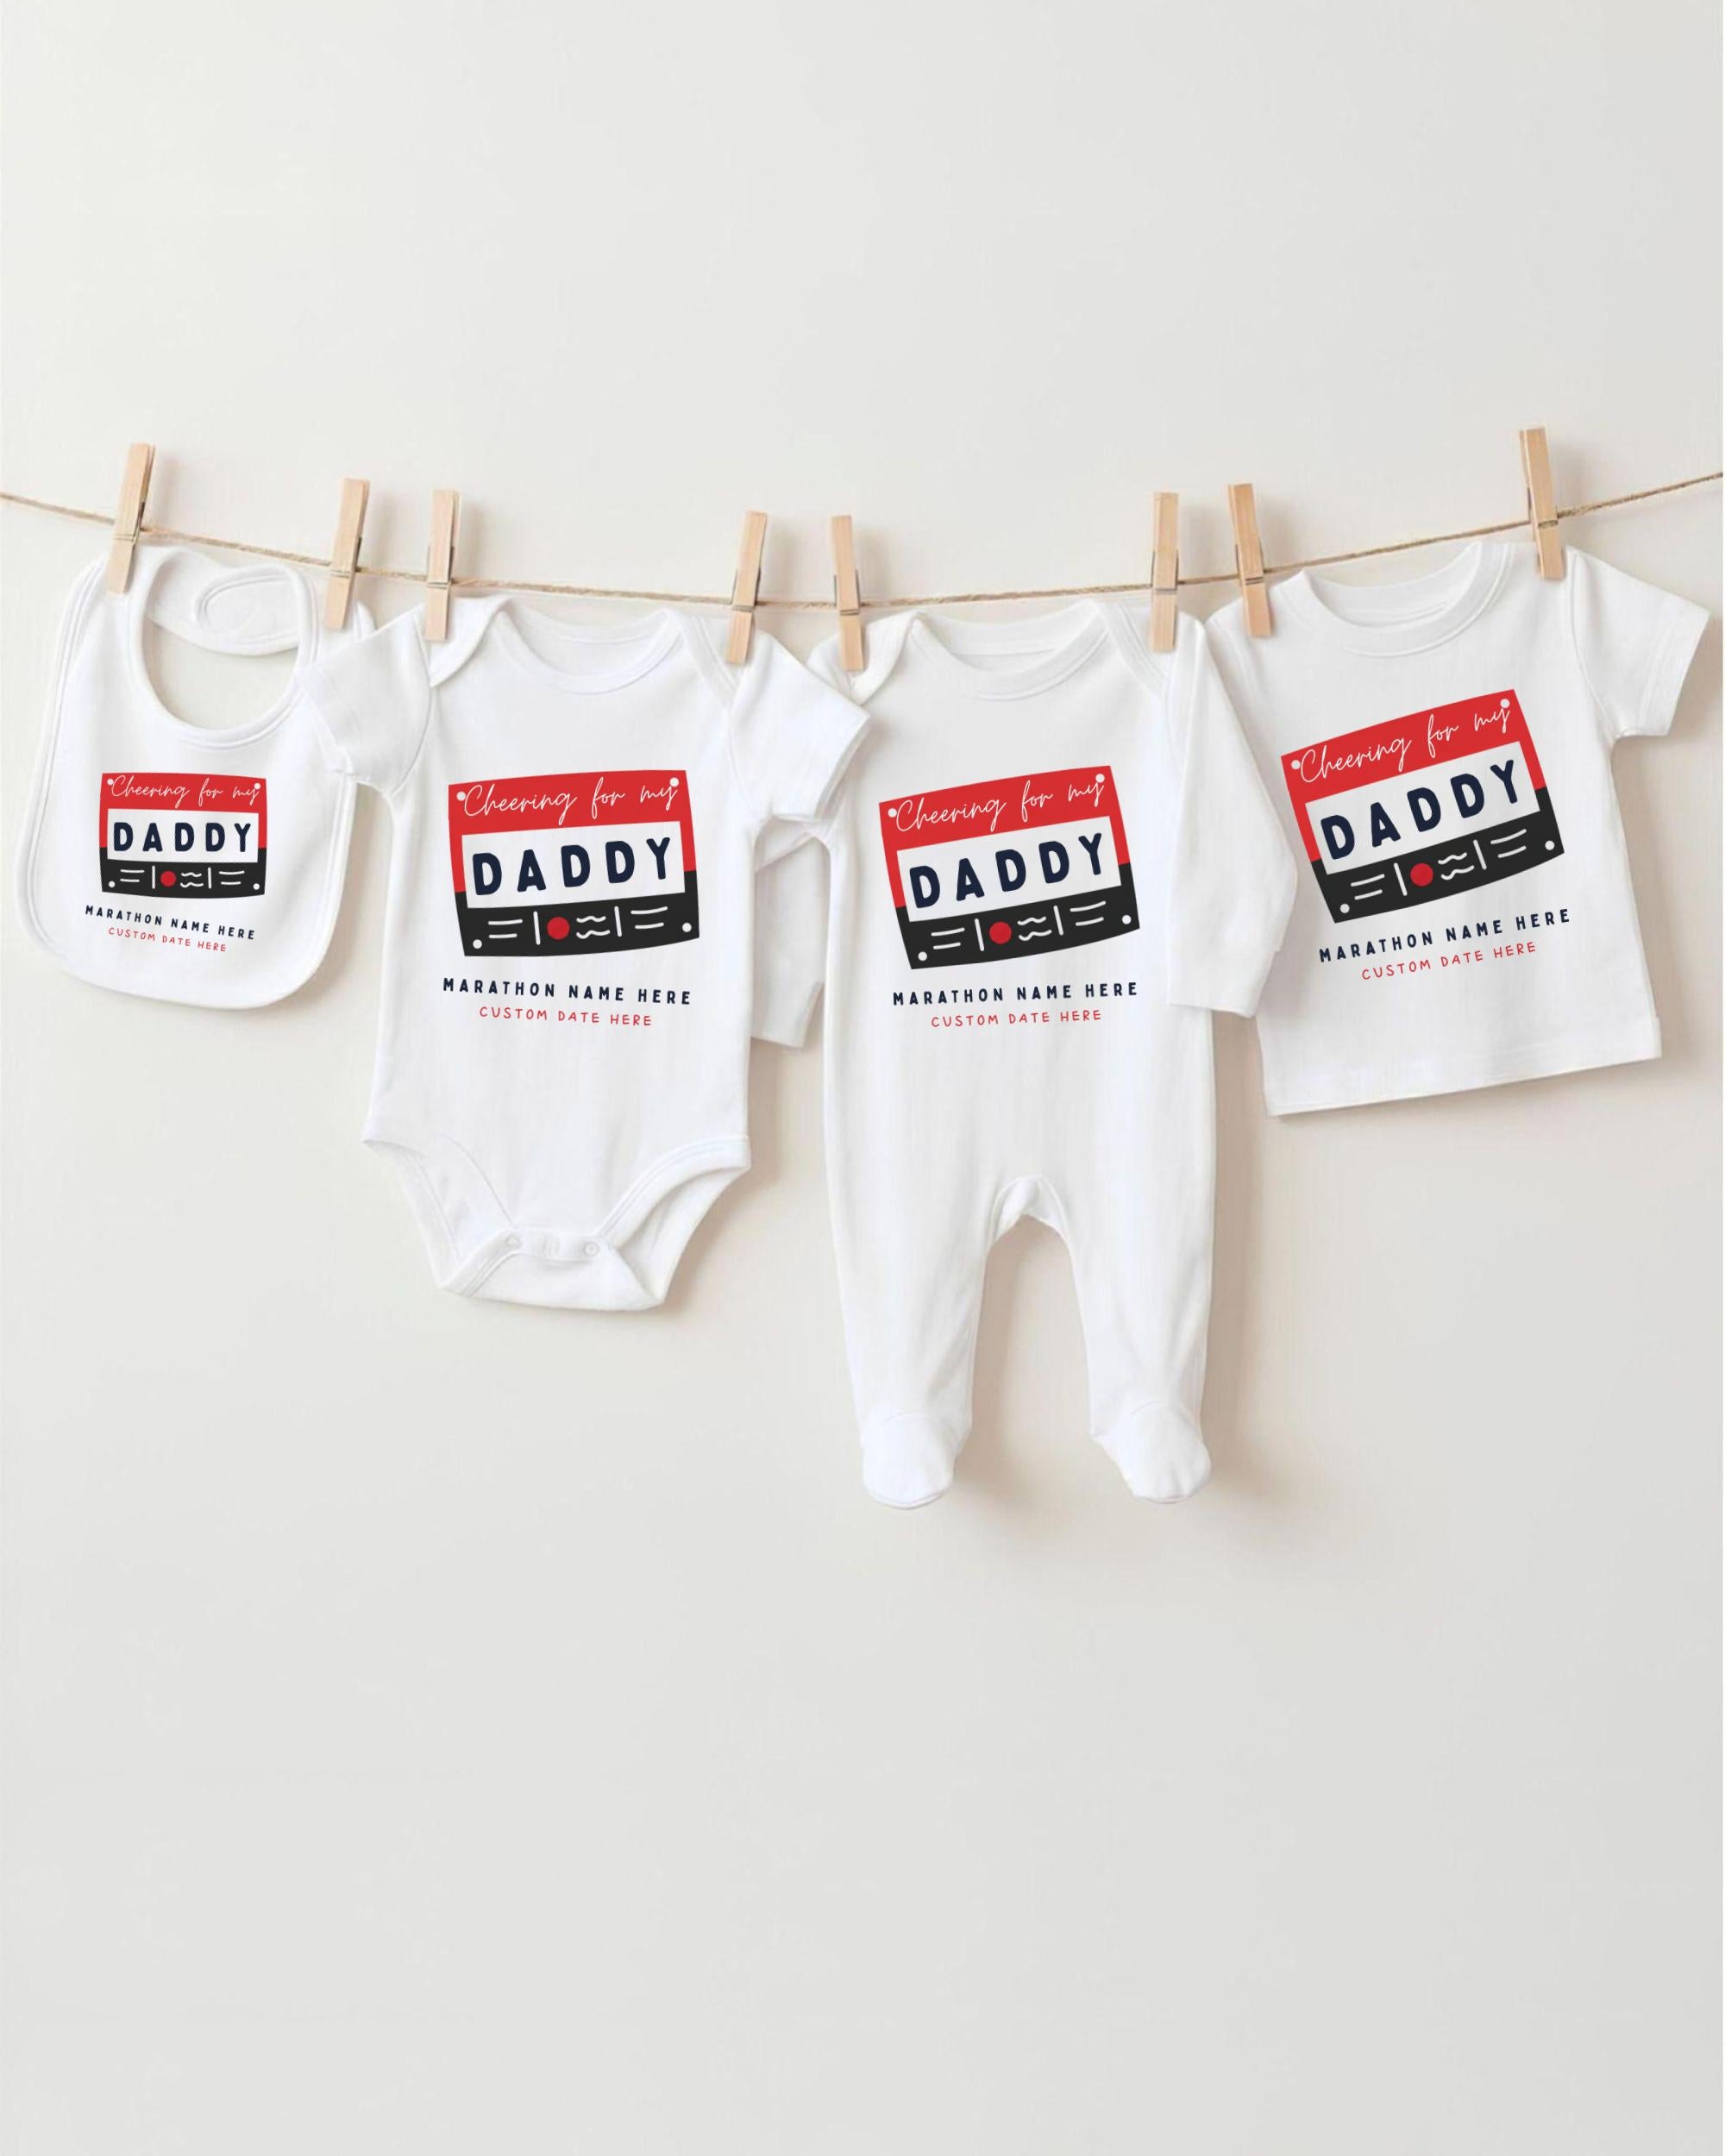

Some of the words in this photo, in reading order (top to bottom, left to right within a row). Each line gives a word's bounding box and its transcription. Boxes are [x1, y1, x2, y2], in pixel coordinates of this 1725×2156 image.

[1300, 734, 1414, 784] Cheering
[1426, 713, 1460, 760] for
[1473, 705, 1512, 735] my
[110, 774, 190, 809] Cheering
[198, 777, 223, 807] for
[231, 783, 260, 806] my
[463, 783, 578, 826] Cheering
[591, 776, 625, 820] for
[639, 782, 679, 812] my
[895, 797, 1007, 832] Cheering
[1021, 780, 1054, 823] for
[1068, 780, 1106, 807] my
[1320, 759, 1518, 861] DADDY
[113, 821, 251, 853] DADDY
[472, 837, 671, 896] DADDY
[909, 832, 1102, 909] DADDY
[85, 905, 162, 926] MARATHON
[171, 918, 210, 933] NAME
[217, 924, 255, 940] HERE
[109, 927, 155, 940] CUSTOM
[161, 935, 191, 947] DATE
[198, 942, 226, 952] HERE
[1319, 931, 1433, 964] MARATHON
[1446, 919, 1503, 943] NAME
[1515, 908, 1570, 931] HERE
[1361, 959, 1432, 981] CUSTOM
[1440, 950, 1483, 967] DATE
[1492, 941, 1535, 958] HERE
[442, 977, 555, 998] MARATHON
[568, 984, 624, 1001] NAME
[637, 988, 690, 1006] HERE
[893, 987, 1003, 1006] MARATHON
[1016, 984, 1072, 1000] NAME
[1085, 981, 1137, 998] HERE
[480, 1006, 548, 1020] CUSTOM
[557, 1009, 599, 1025] DATE
[610, 1013, 651, 1027] HERE
[931, 1013, 999, 1028] CUSTOM
[1007, 1011, 1050, 1025] DATE
[1059, 1009, 1101, 1022] HERE
